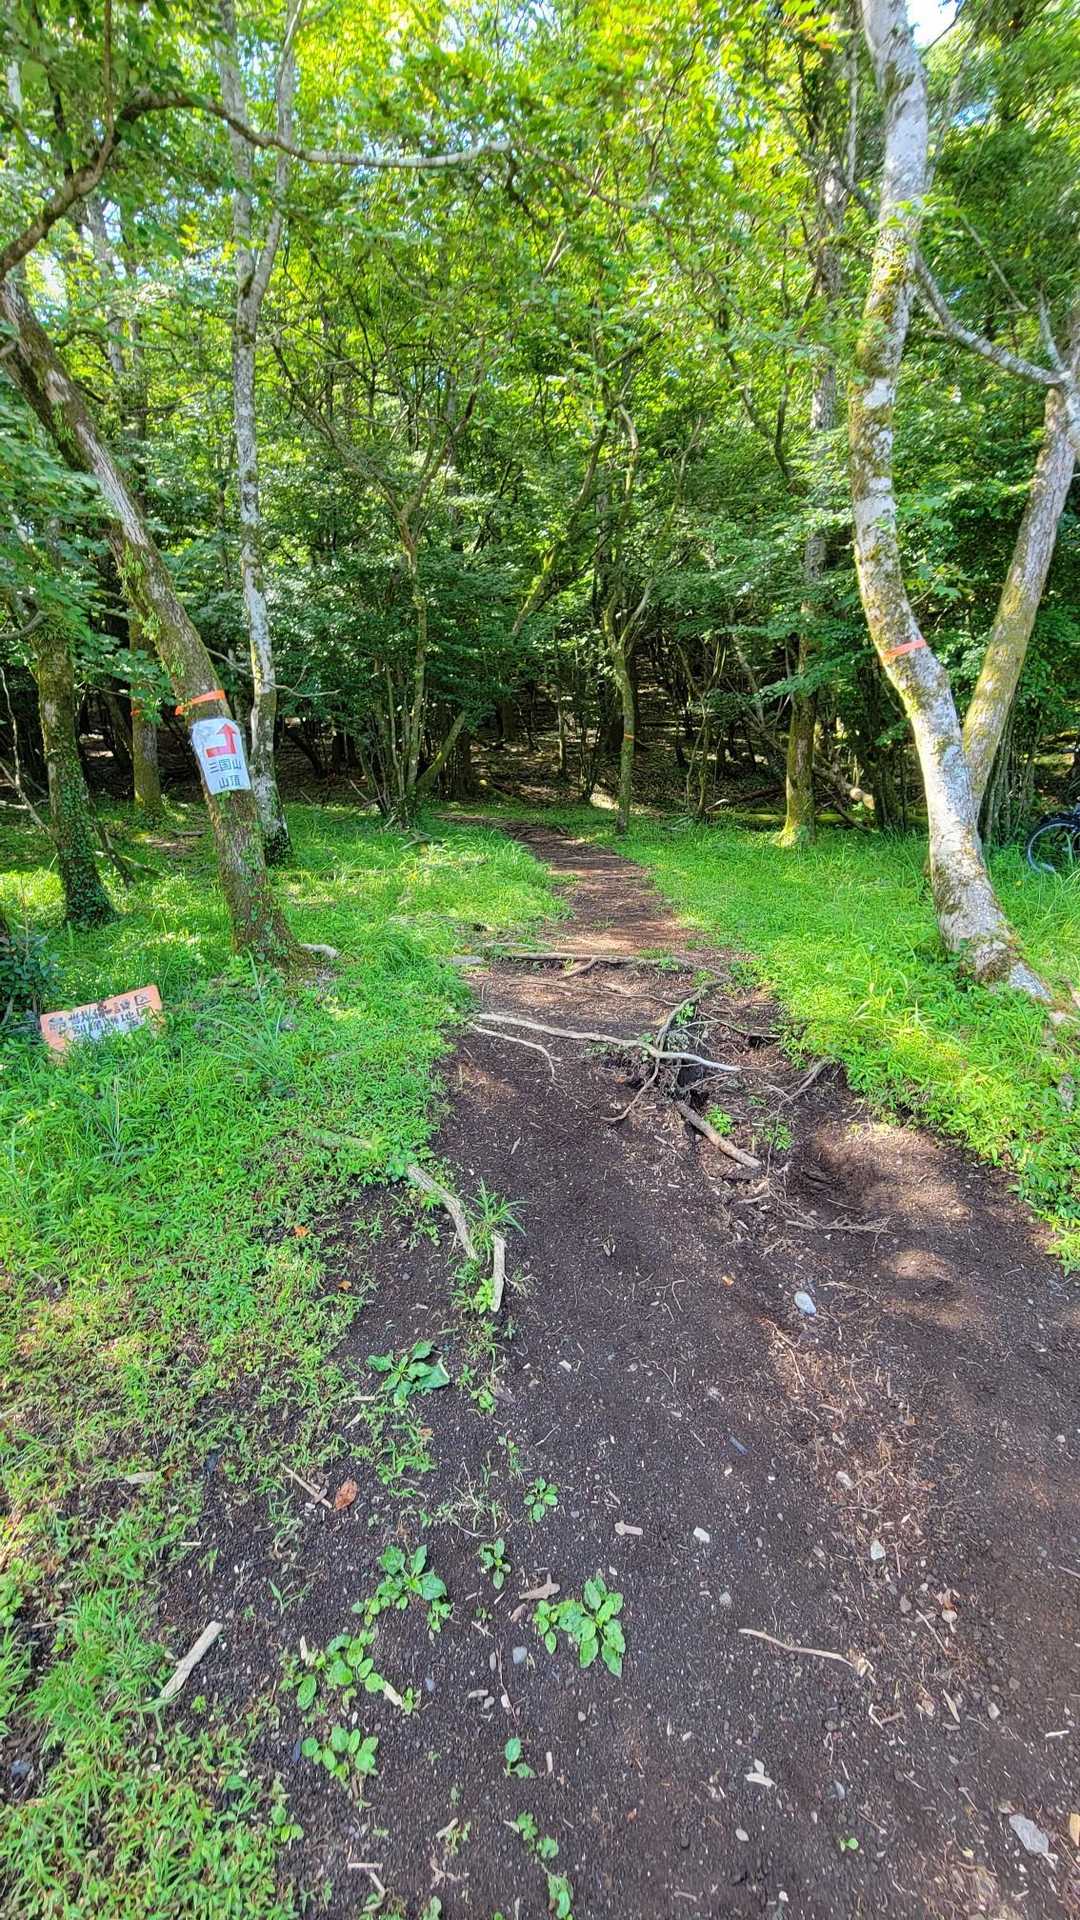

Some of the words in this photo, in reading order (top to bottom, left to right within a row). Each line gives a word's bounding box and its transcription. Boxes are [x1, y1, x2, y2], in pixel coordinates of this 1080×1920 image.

[208, 758, 242, 774] 三国山
[218, 775, 241, 788] 山頂
